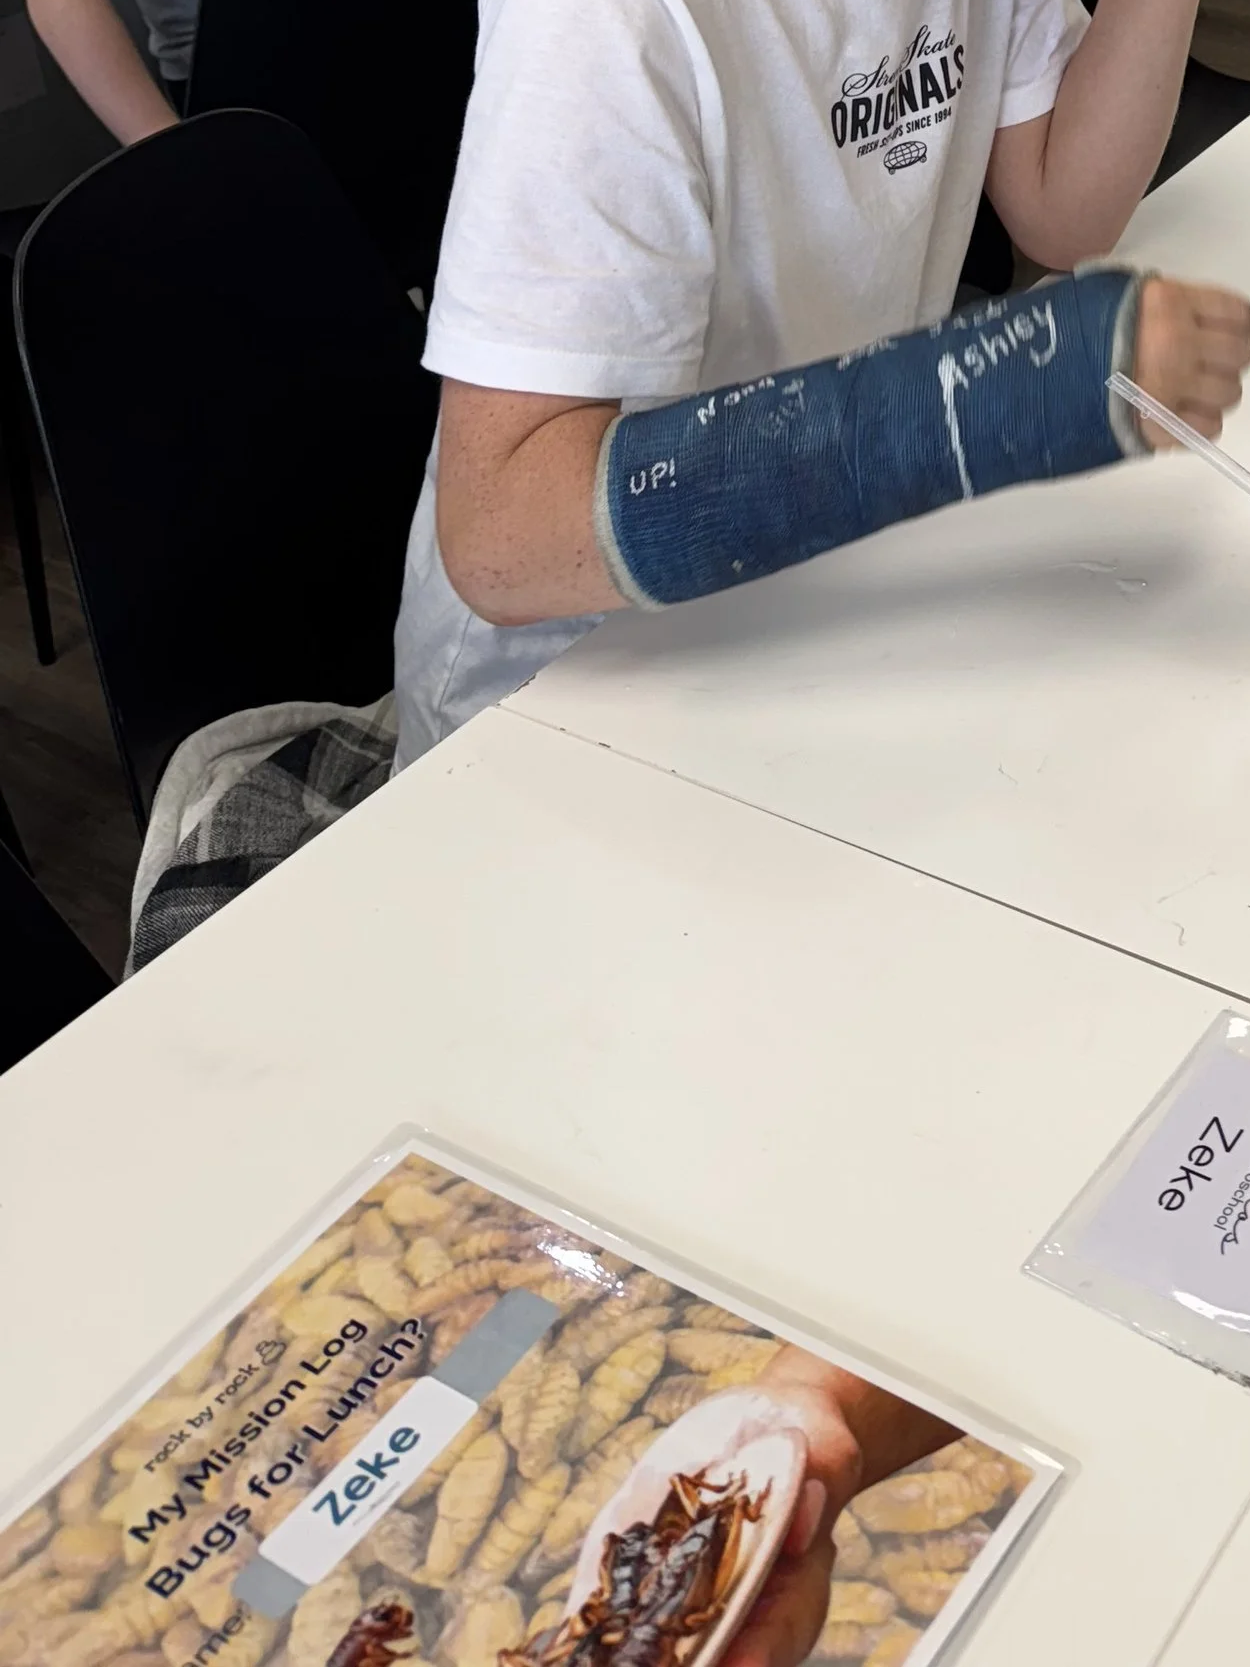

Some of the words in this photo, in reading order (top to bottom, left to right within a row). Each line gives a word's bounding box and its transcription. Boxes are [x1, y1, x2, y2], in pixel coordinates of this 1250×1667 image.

[905, 114, 932, 134] SINCE
[628, 457, 678, 498] UP!
[1157, 1114, 1245, 1212] Zeke
[127, 1492, 189, 1545] My
[182, 1379, 308, 1494] Mission
[299, 1317, 370, 1377] Log
[142, 1427, 192, 1474] rock
[185, 1402, 215, 1432] by
[214, 1362, 261, 1406] rock
[143, 1500, 252, 1600] Bugs
[246, 1443, 307, 1501] for
[301, 1316, 427, 1443] Lunch?
[311, 1424, 423, 1528] Zeke
